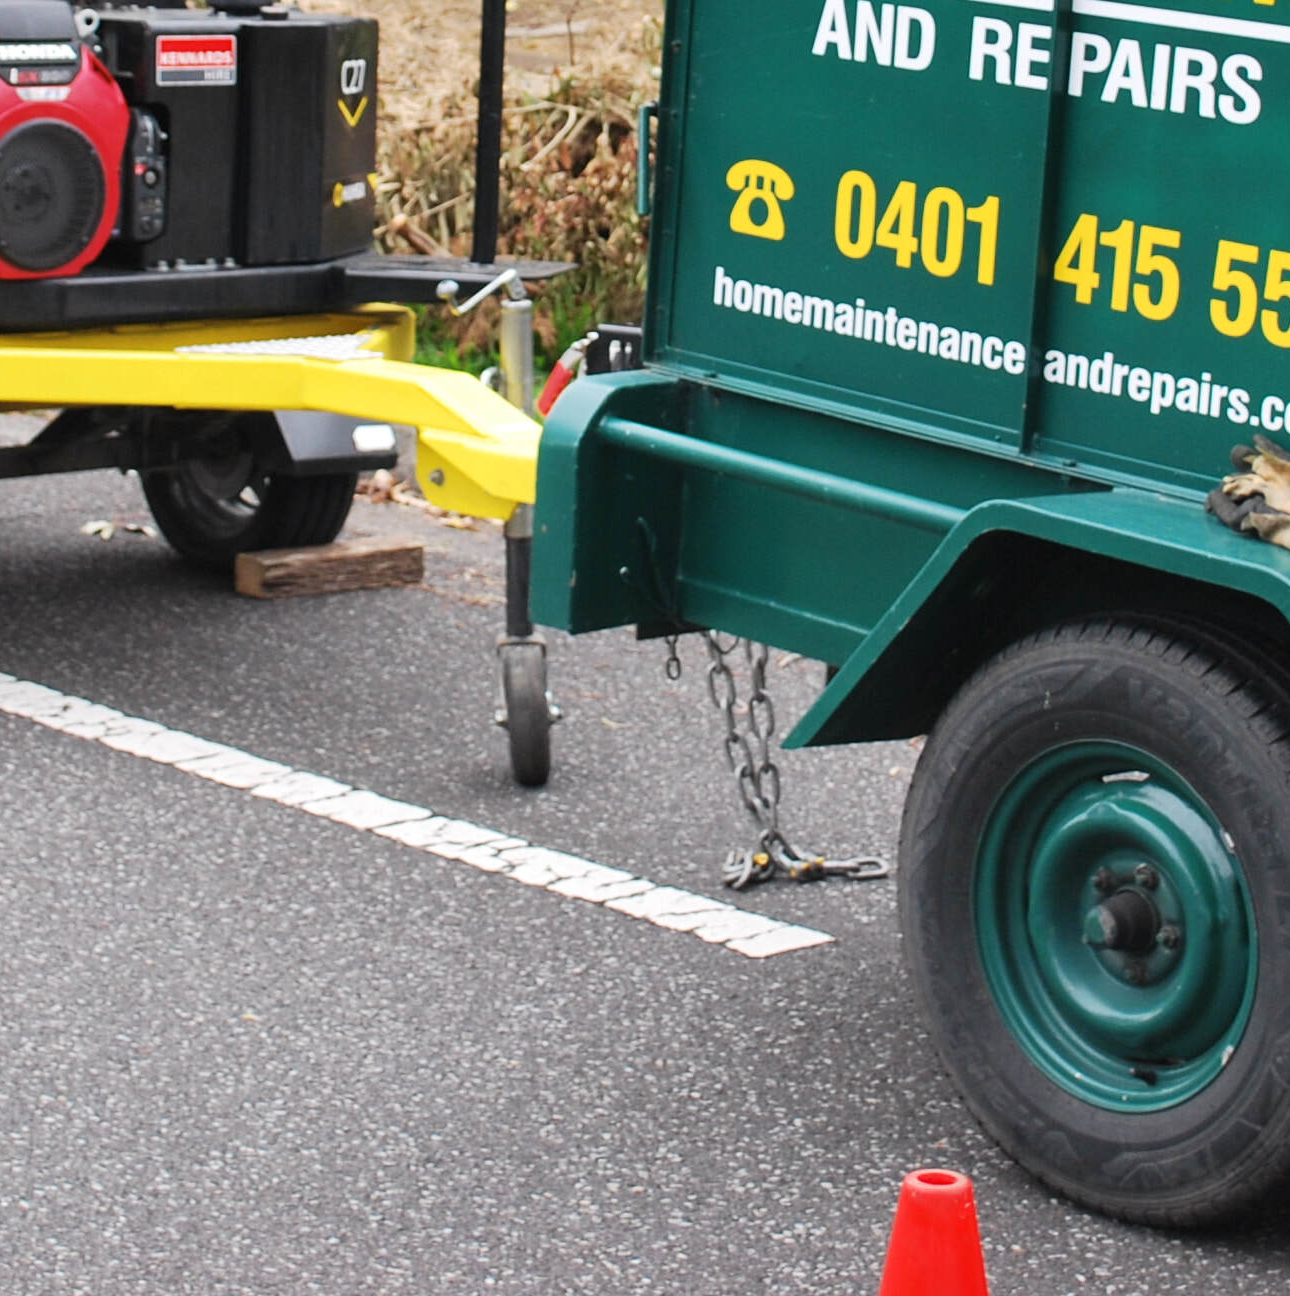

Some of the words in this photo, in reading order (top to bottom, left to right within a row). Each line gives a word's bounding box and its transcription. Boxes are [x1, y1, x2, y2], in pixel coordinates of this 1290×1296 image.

[160, 51, 234, 65] KENNARDS
[835, 170, 1000, 286] 0401
[1054, 213, 1181, 321] 415
